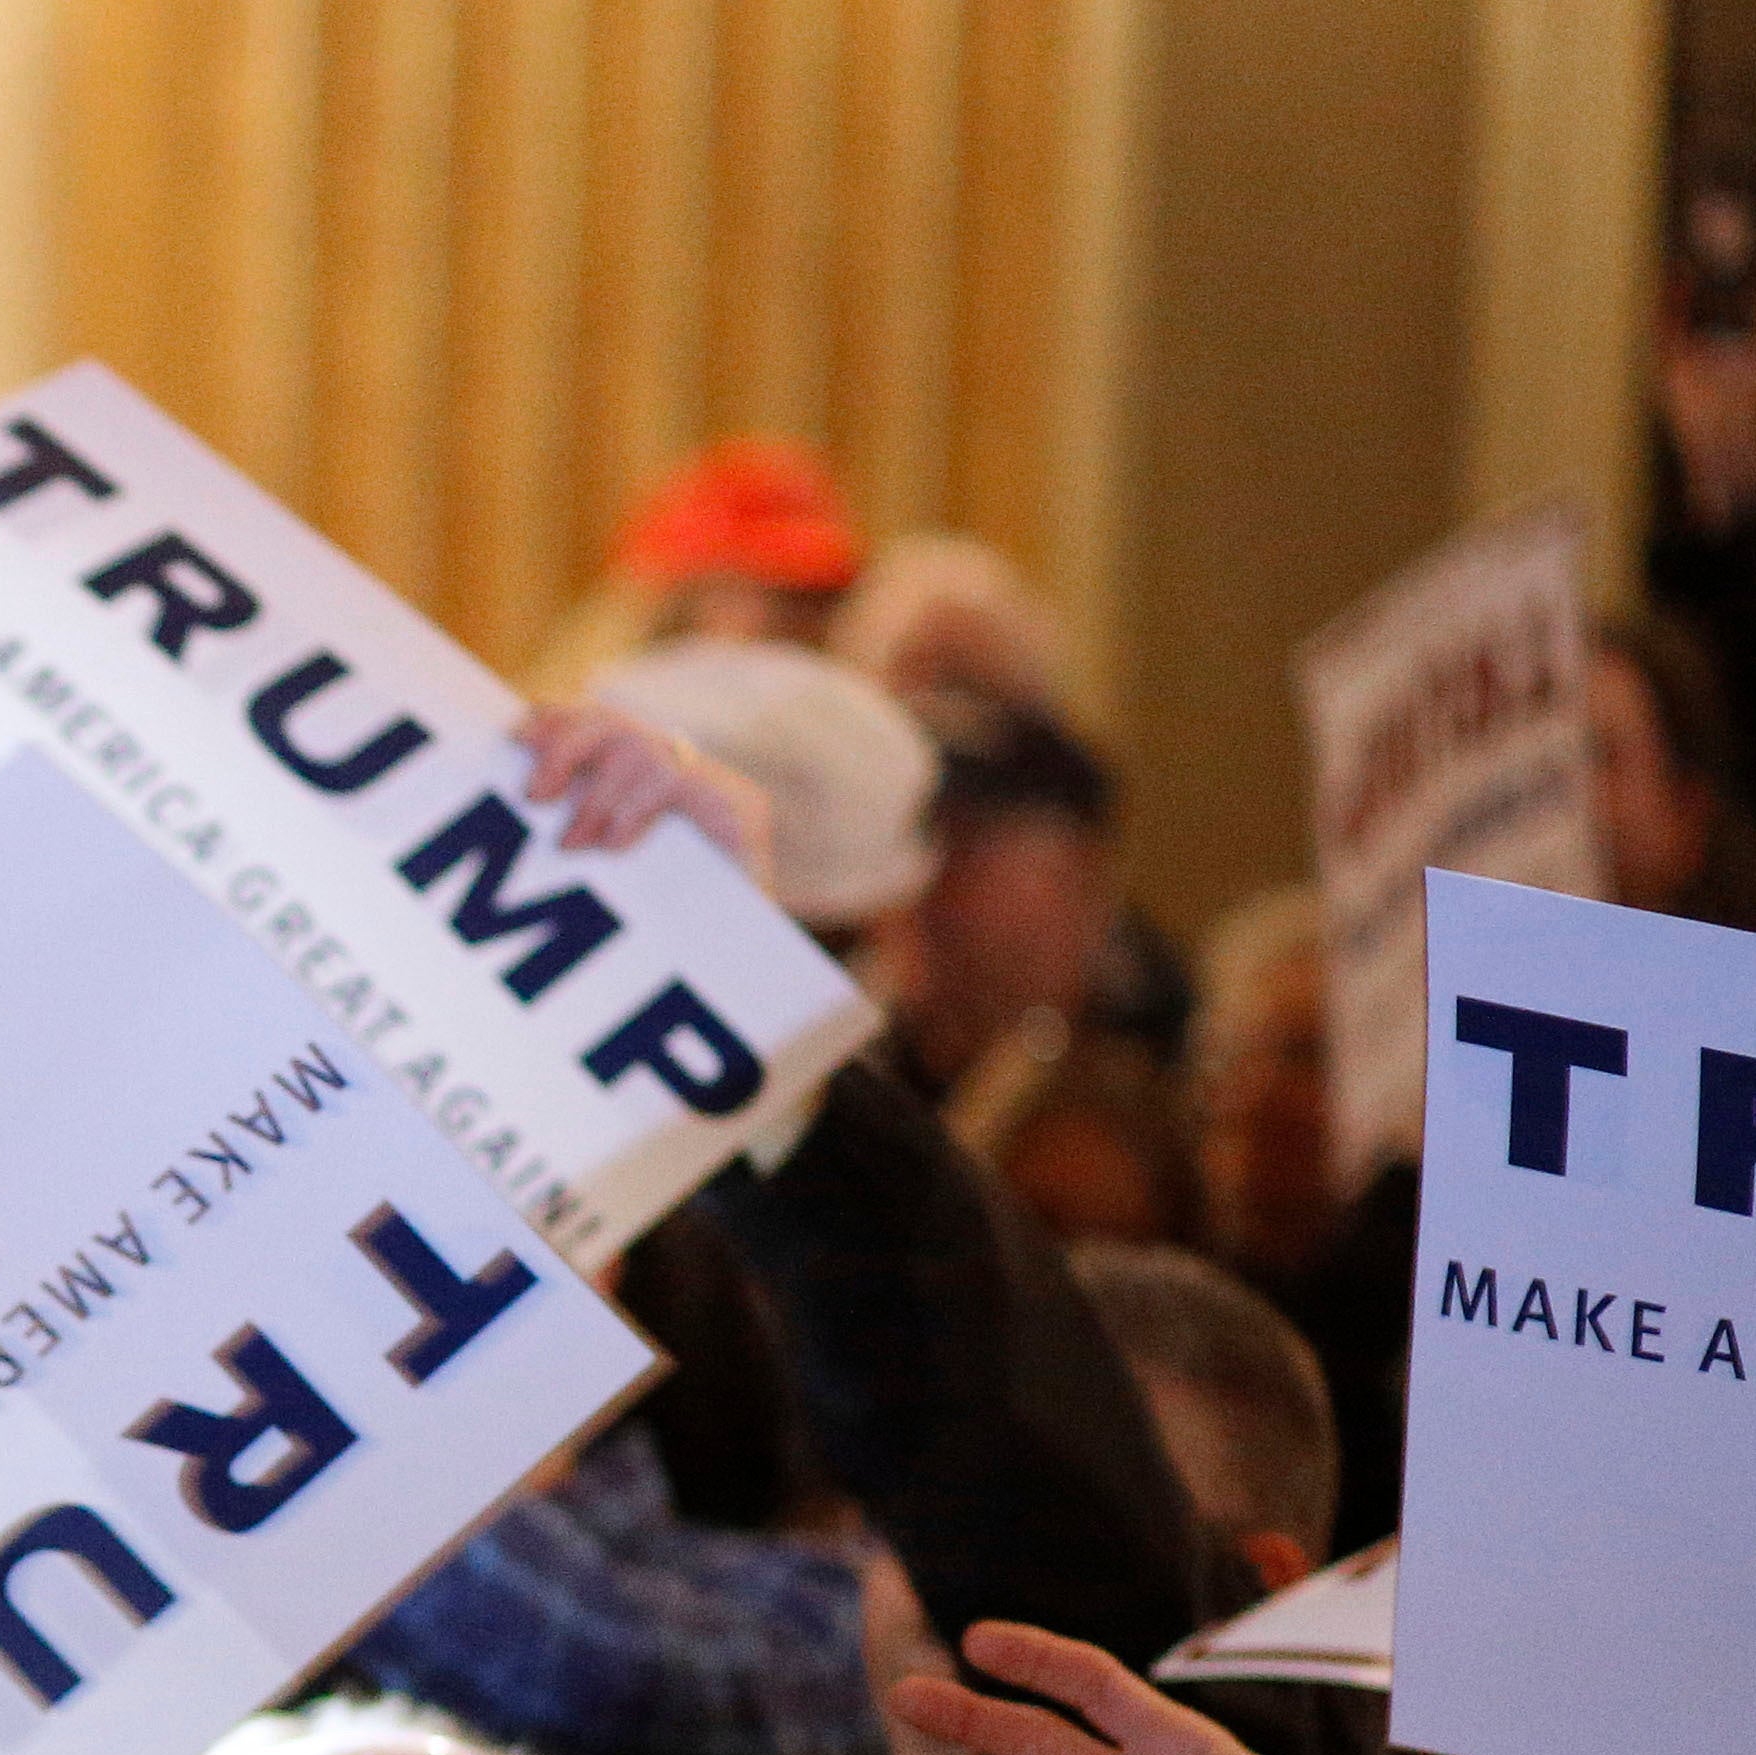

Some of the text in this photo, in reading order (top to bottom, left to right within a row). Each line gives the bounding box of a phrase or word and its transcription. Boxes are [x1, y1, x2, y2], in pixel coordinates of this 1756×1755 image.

[225, 862, 412, 1049] GREAT
[150, 1041, 348, 1226] MAKE
[1440, 1259, 1667, 1363] MAKE
